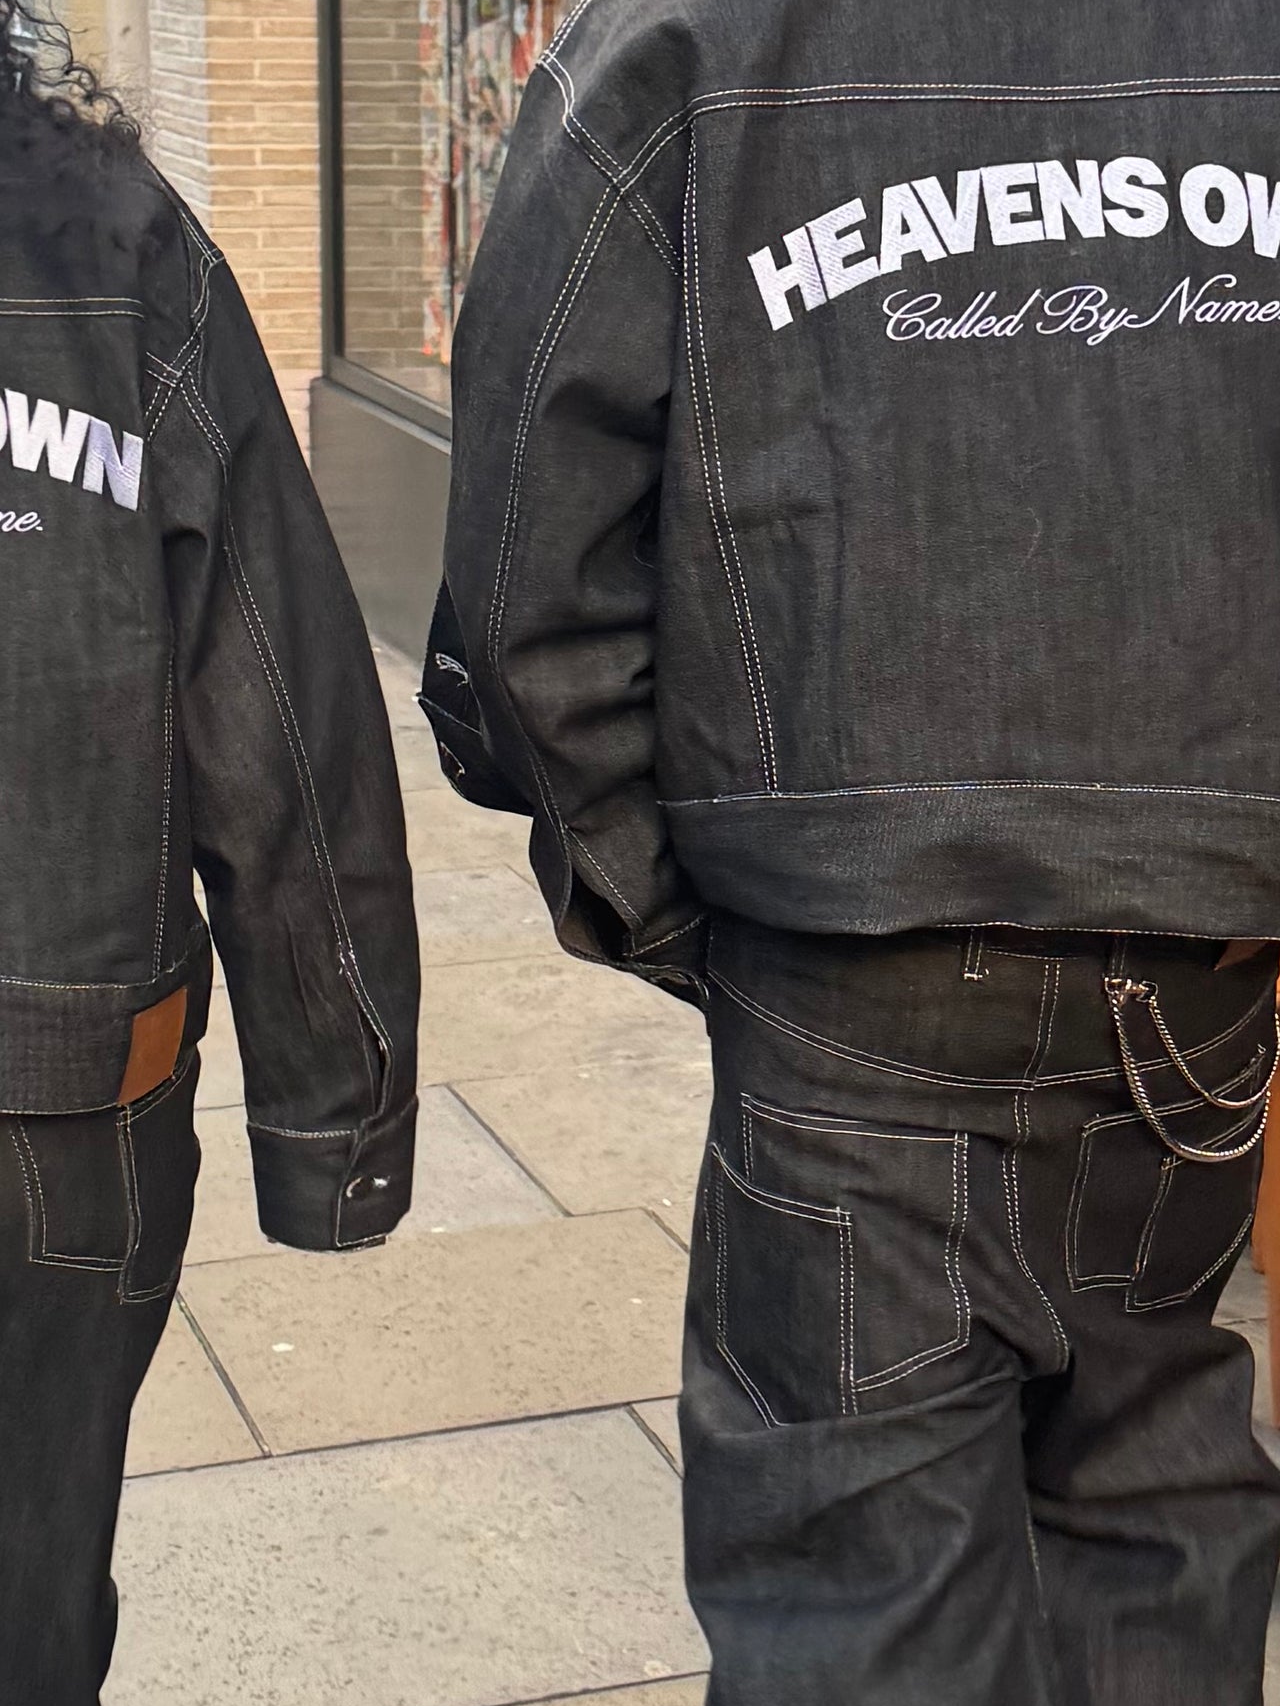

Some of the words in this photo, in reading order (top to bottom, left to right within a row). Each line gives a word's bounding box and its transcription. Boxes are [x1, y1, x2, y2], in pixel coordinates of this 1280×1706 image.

[747, 156, 1169, 330] HEAVENS
[882, 288, 1041, 341] Called
[1036, 284, 1120, 346] By
